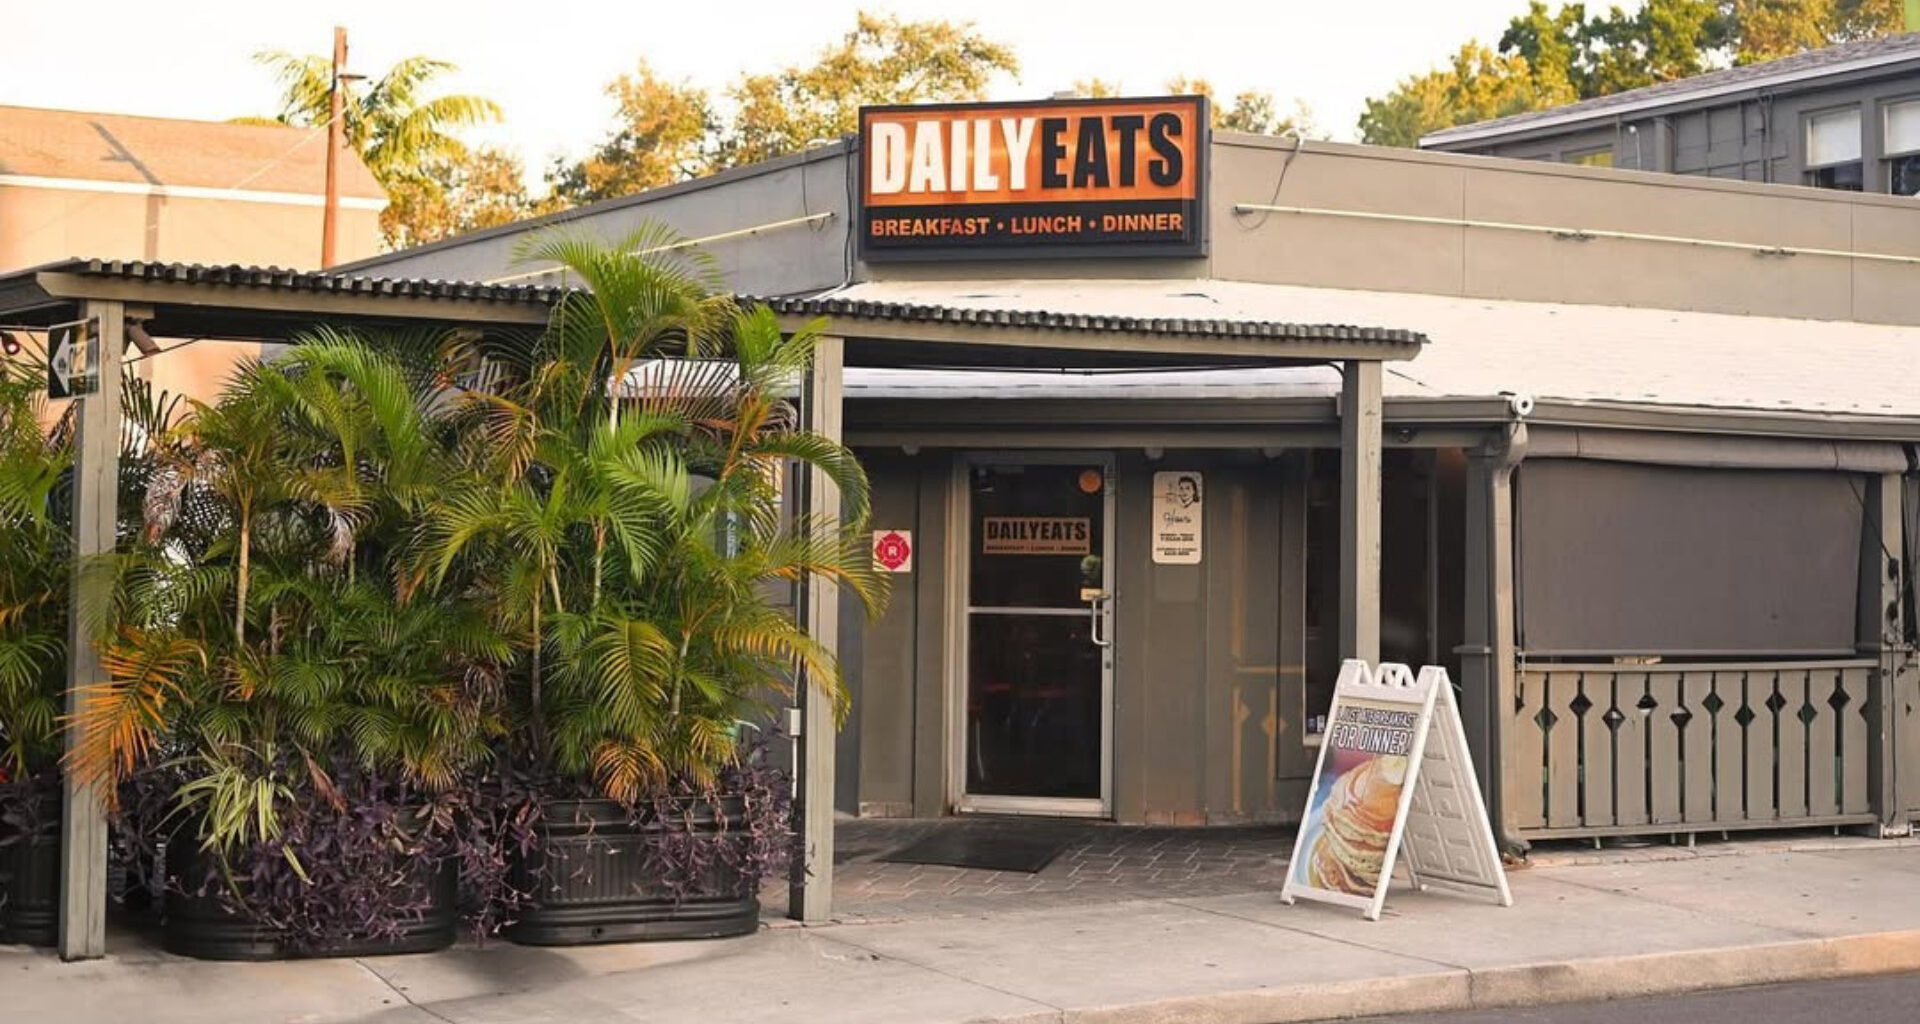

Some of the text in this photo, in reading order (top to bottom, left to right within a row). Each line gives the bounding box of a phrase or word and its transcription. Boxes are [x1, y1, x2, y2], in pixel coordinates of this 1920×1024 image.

[871, 213, 1184, 236] BREAKFAST LUNCH DINNER
[888, 545, 898, 557] R
[1330, 722, 1358, 751] FOR
